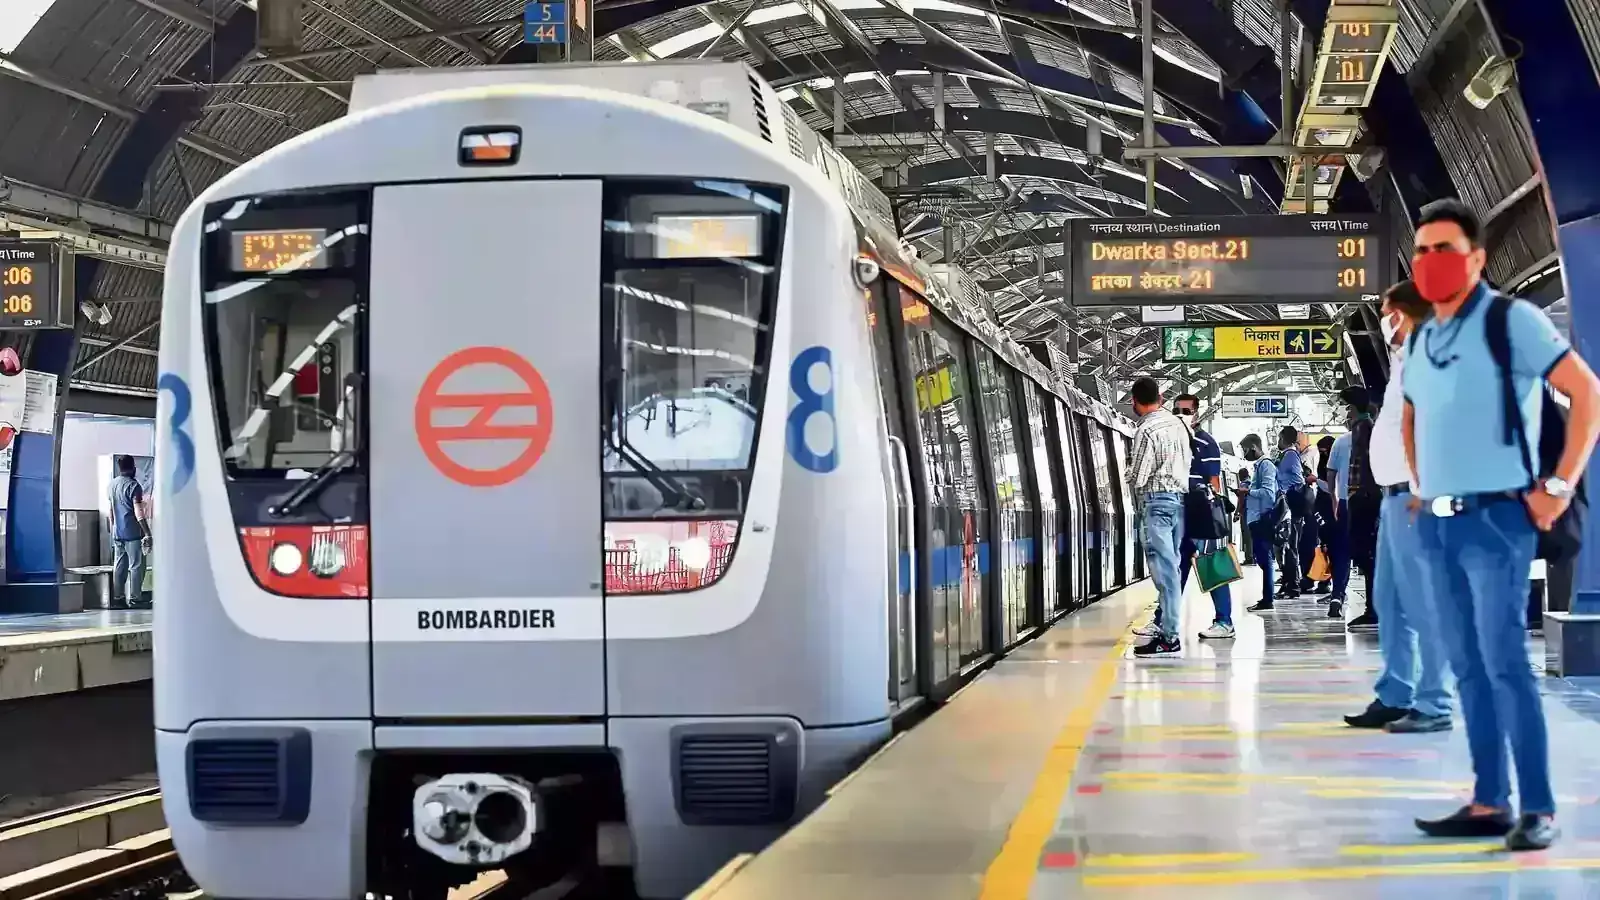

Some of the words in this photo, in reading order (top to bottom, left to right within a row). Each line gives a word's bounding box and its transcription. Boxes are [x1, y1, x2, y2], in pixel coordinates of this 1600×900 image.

[542, 4, 552, 21] 5
[534, 24, 558, 42] 44
[1090, 223, 1123, 236] गन्तव्य
[1092, 241, 1166, 261] Dwarka
[1173, 239, 1248, 260] Sect.21
[1337, 238, 1366, 257] :01
[4, 266, 32, 286] :06
[1190, 270, 1213, 289] 21
[1337, 267, 1366, 287] :01
[4, 295, 32, 314] :06
[1243, 327, 1280, 341] निकास
[1258, 345, 1280, 356] Exit
[785, 346, 839, 473] 8
[418, 609, 555, 629] BOMBARDIER
